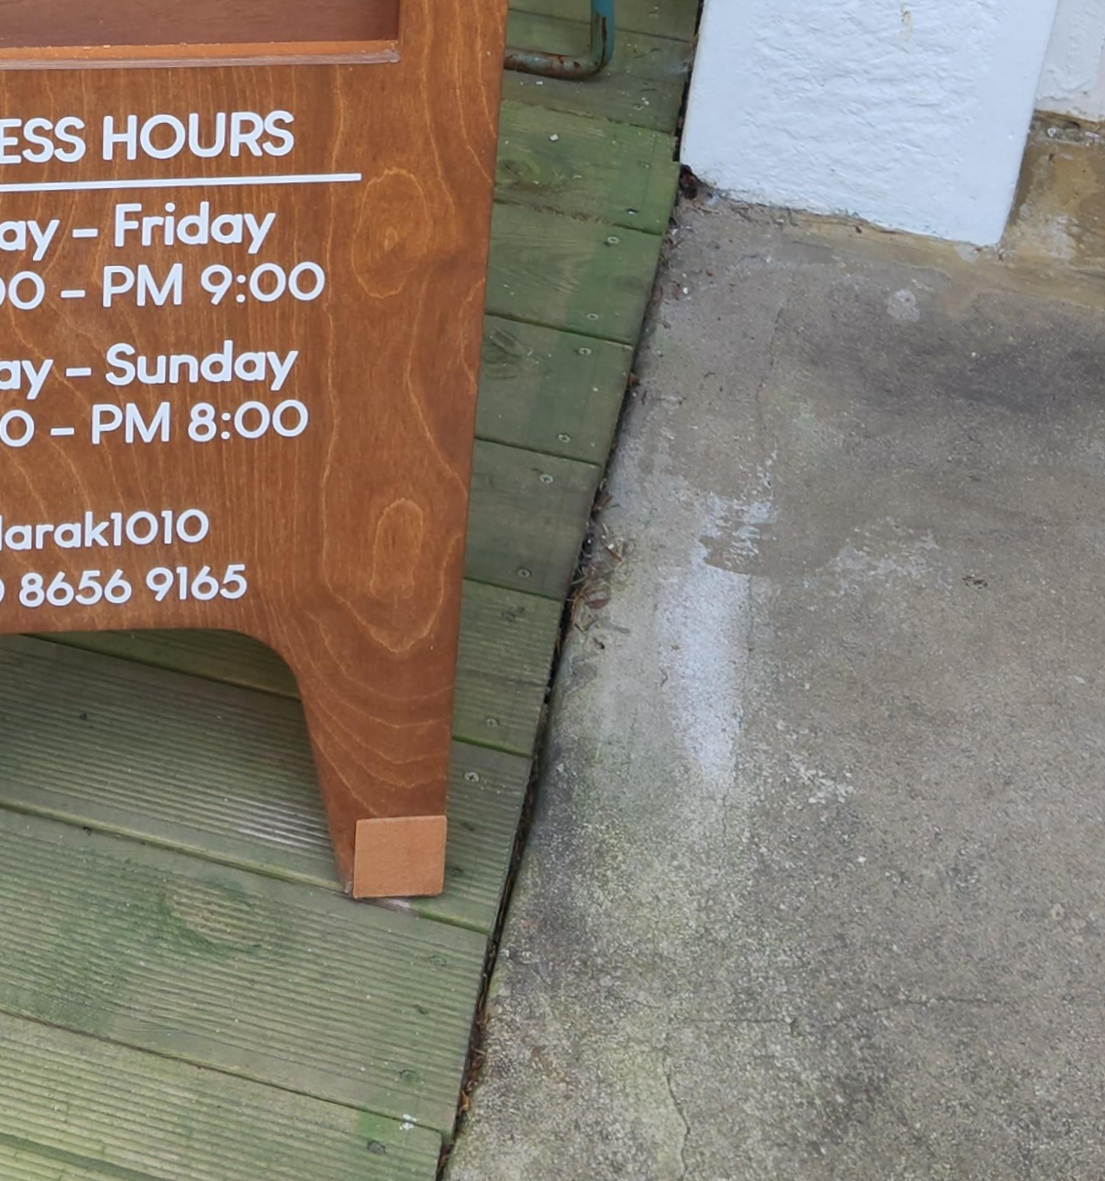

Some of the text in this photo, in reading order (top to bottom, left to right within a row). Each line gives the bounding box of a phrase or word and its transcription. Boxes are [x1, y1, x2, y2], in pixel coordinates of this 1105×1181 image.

[101, 109, 296, 162] HOURS
[113, 200, 277, 255] Friday
[101, 262, 184, 309] PM
[199, 260, 326, 306] 9:00
[104, 338, 300, 392] Sunday
[90, 400, 172, 446] PM
[186, 398, 310, 443] 8:00
[18, 568, 133, 609] 8656
[144, 562, 248, 603] 9165
